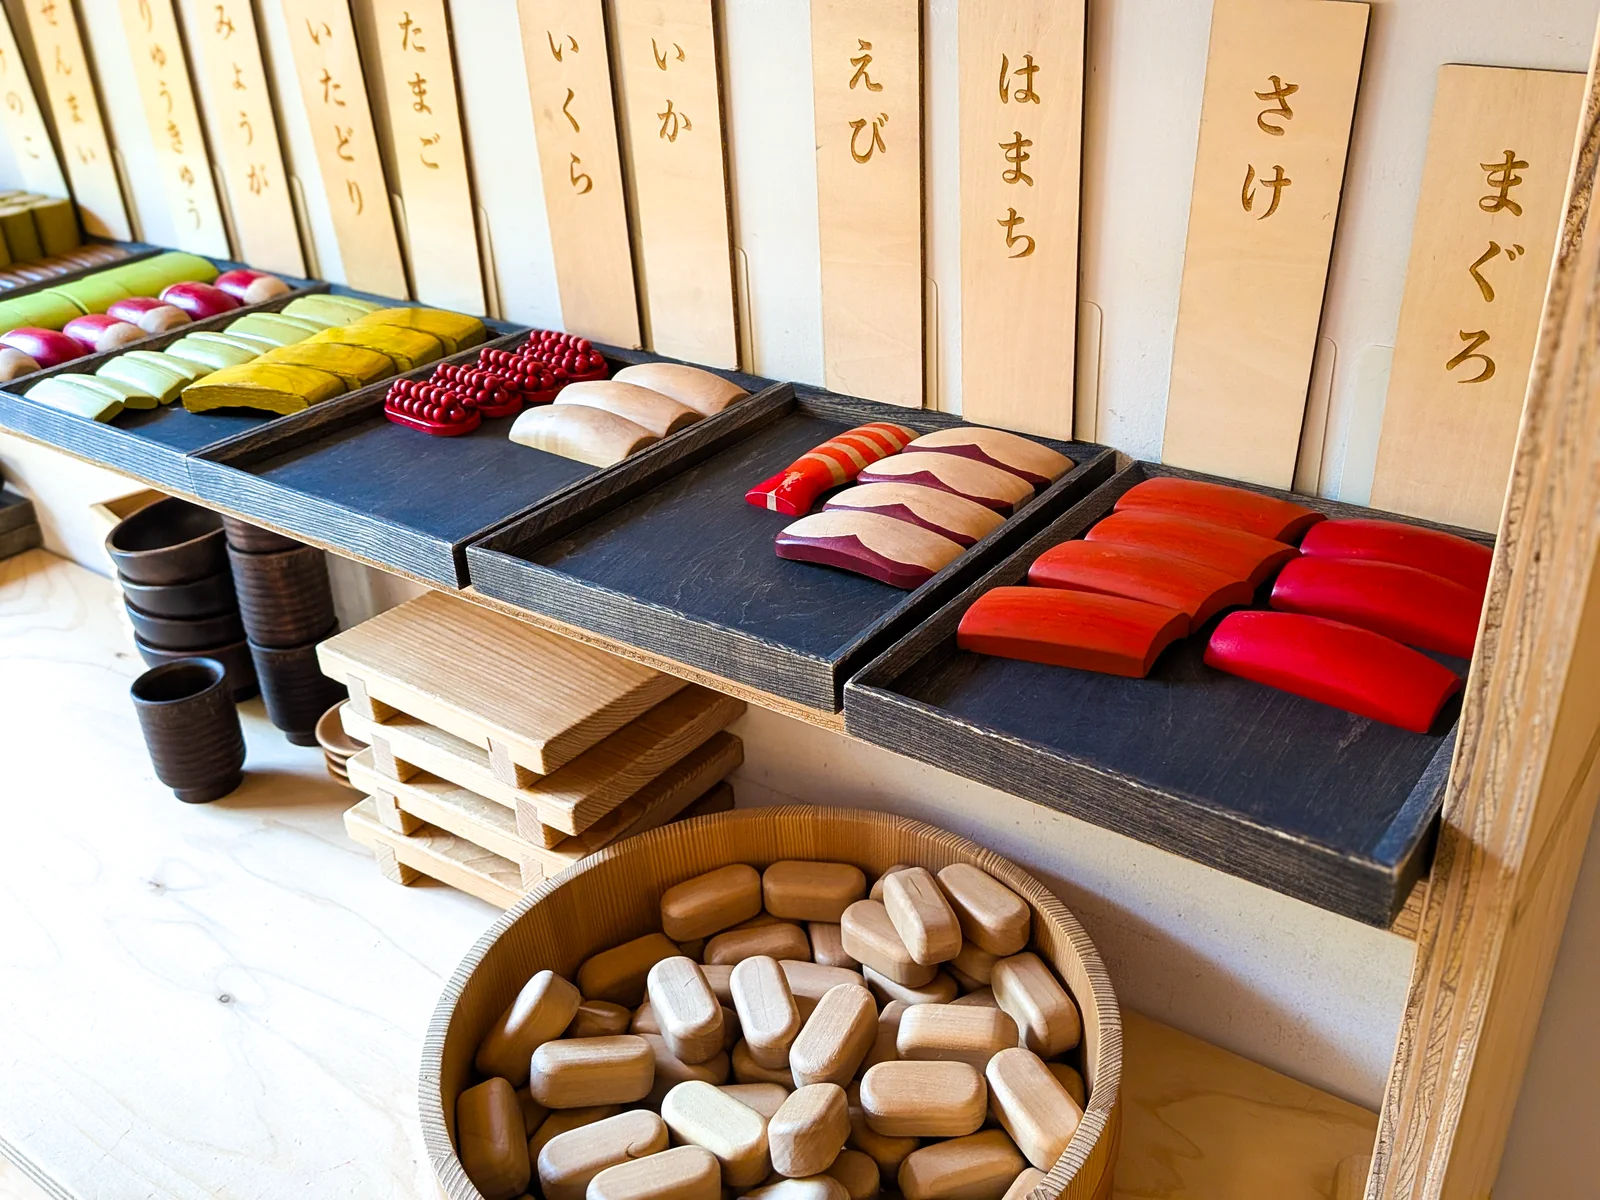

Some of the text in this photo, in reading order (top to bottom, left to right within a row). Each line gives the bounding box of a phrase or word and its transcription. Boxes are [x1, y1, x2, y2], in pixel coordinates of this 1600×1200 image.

[305, 17, 364, 216] いたどり
[398, 11, 441, 170] たまご
[546, 29, 594, 195] いくら
[650, 37, 693, 143] いか
[848, 38, 890, 165] えび
[997, 53, 1041, 259] はまち
[1240, 74, 1300, 221] さけ
[1445, 149, 1531, 384] まぐろ
